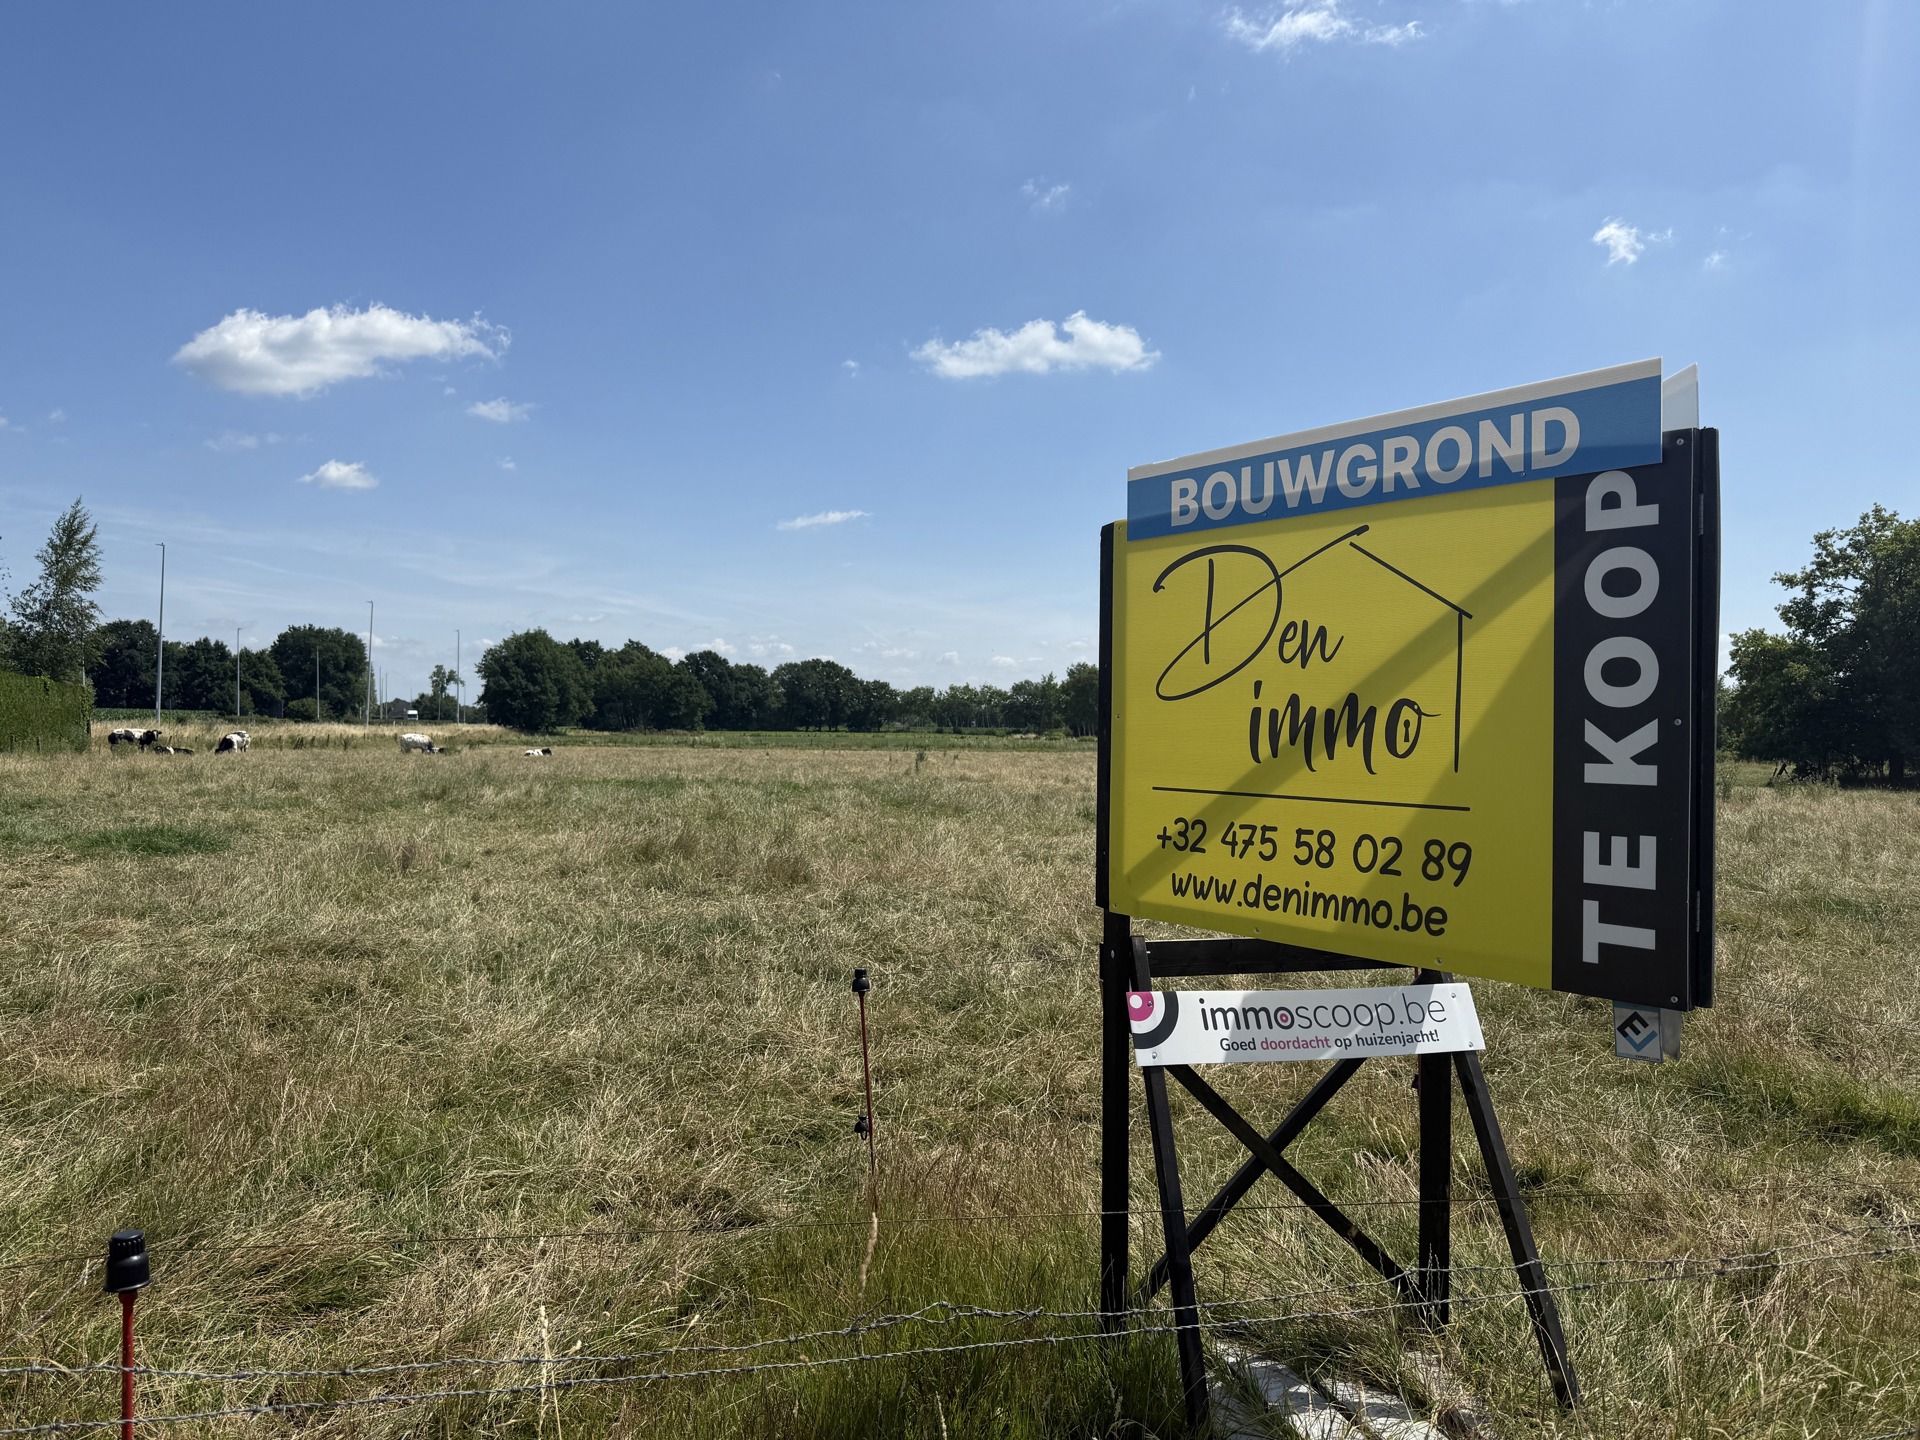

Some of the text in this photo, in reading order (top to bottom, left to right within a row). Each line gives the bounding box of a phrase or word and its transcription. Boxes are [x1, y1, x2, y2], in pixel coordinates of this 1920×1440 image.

[1170, 406, 1581, 526] BOUWGROND
[1152, 544, 1344, 701] Den
[1584, 470, 1660, 786] KOOP
[1249, 680, 1442, 775] immo
[1157, 817, 1472, 887] +32 475 58 02 89
[1582, 830, 1658, 964] TE
[1171, 872, 1448, 937] www.denimmo.be
[1199, 993, 1447, 1033] immoscoop.be
[1219, 1029, 1440, 1051] Goed doordacht op huizenjacht!
